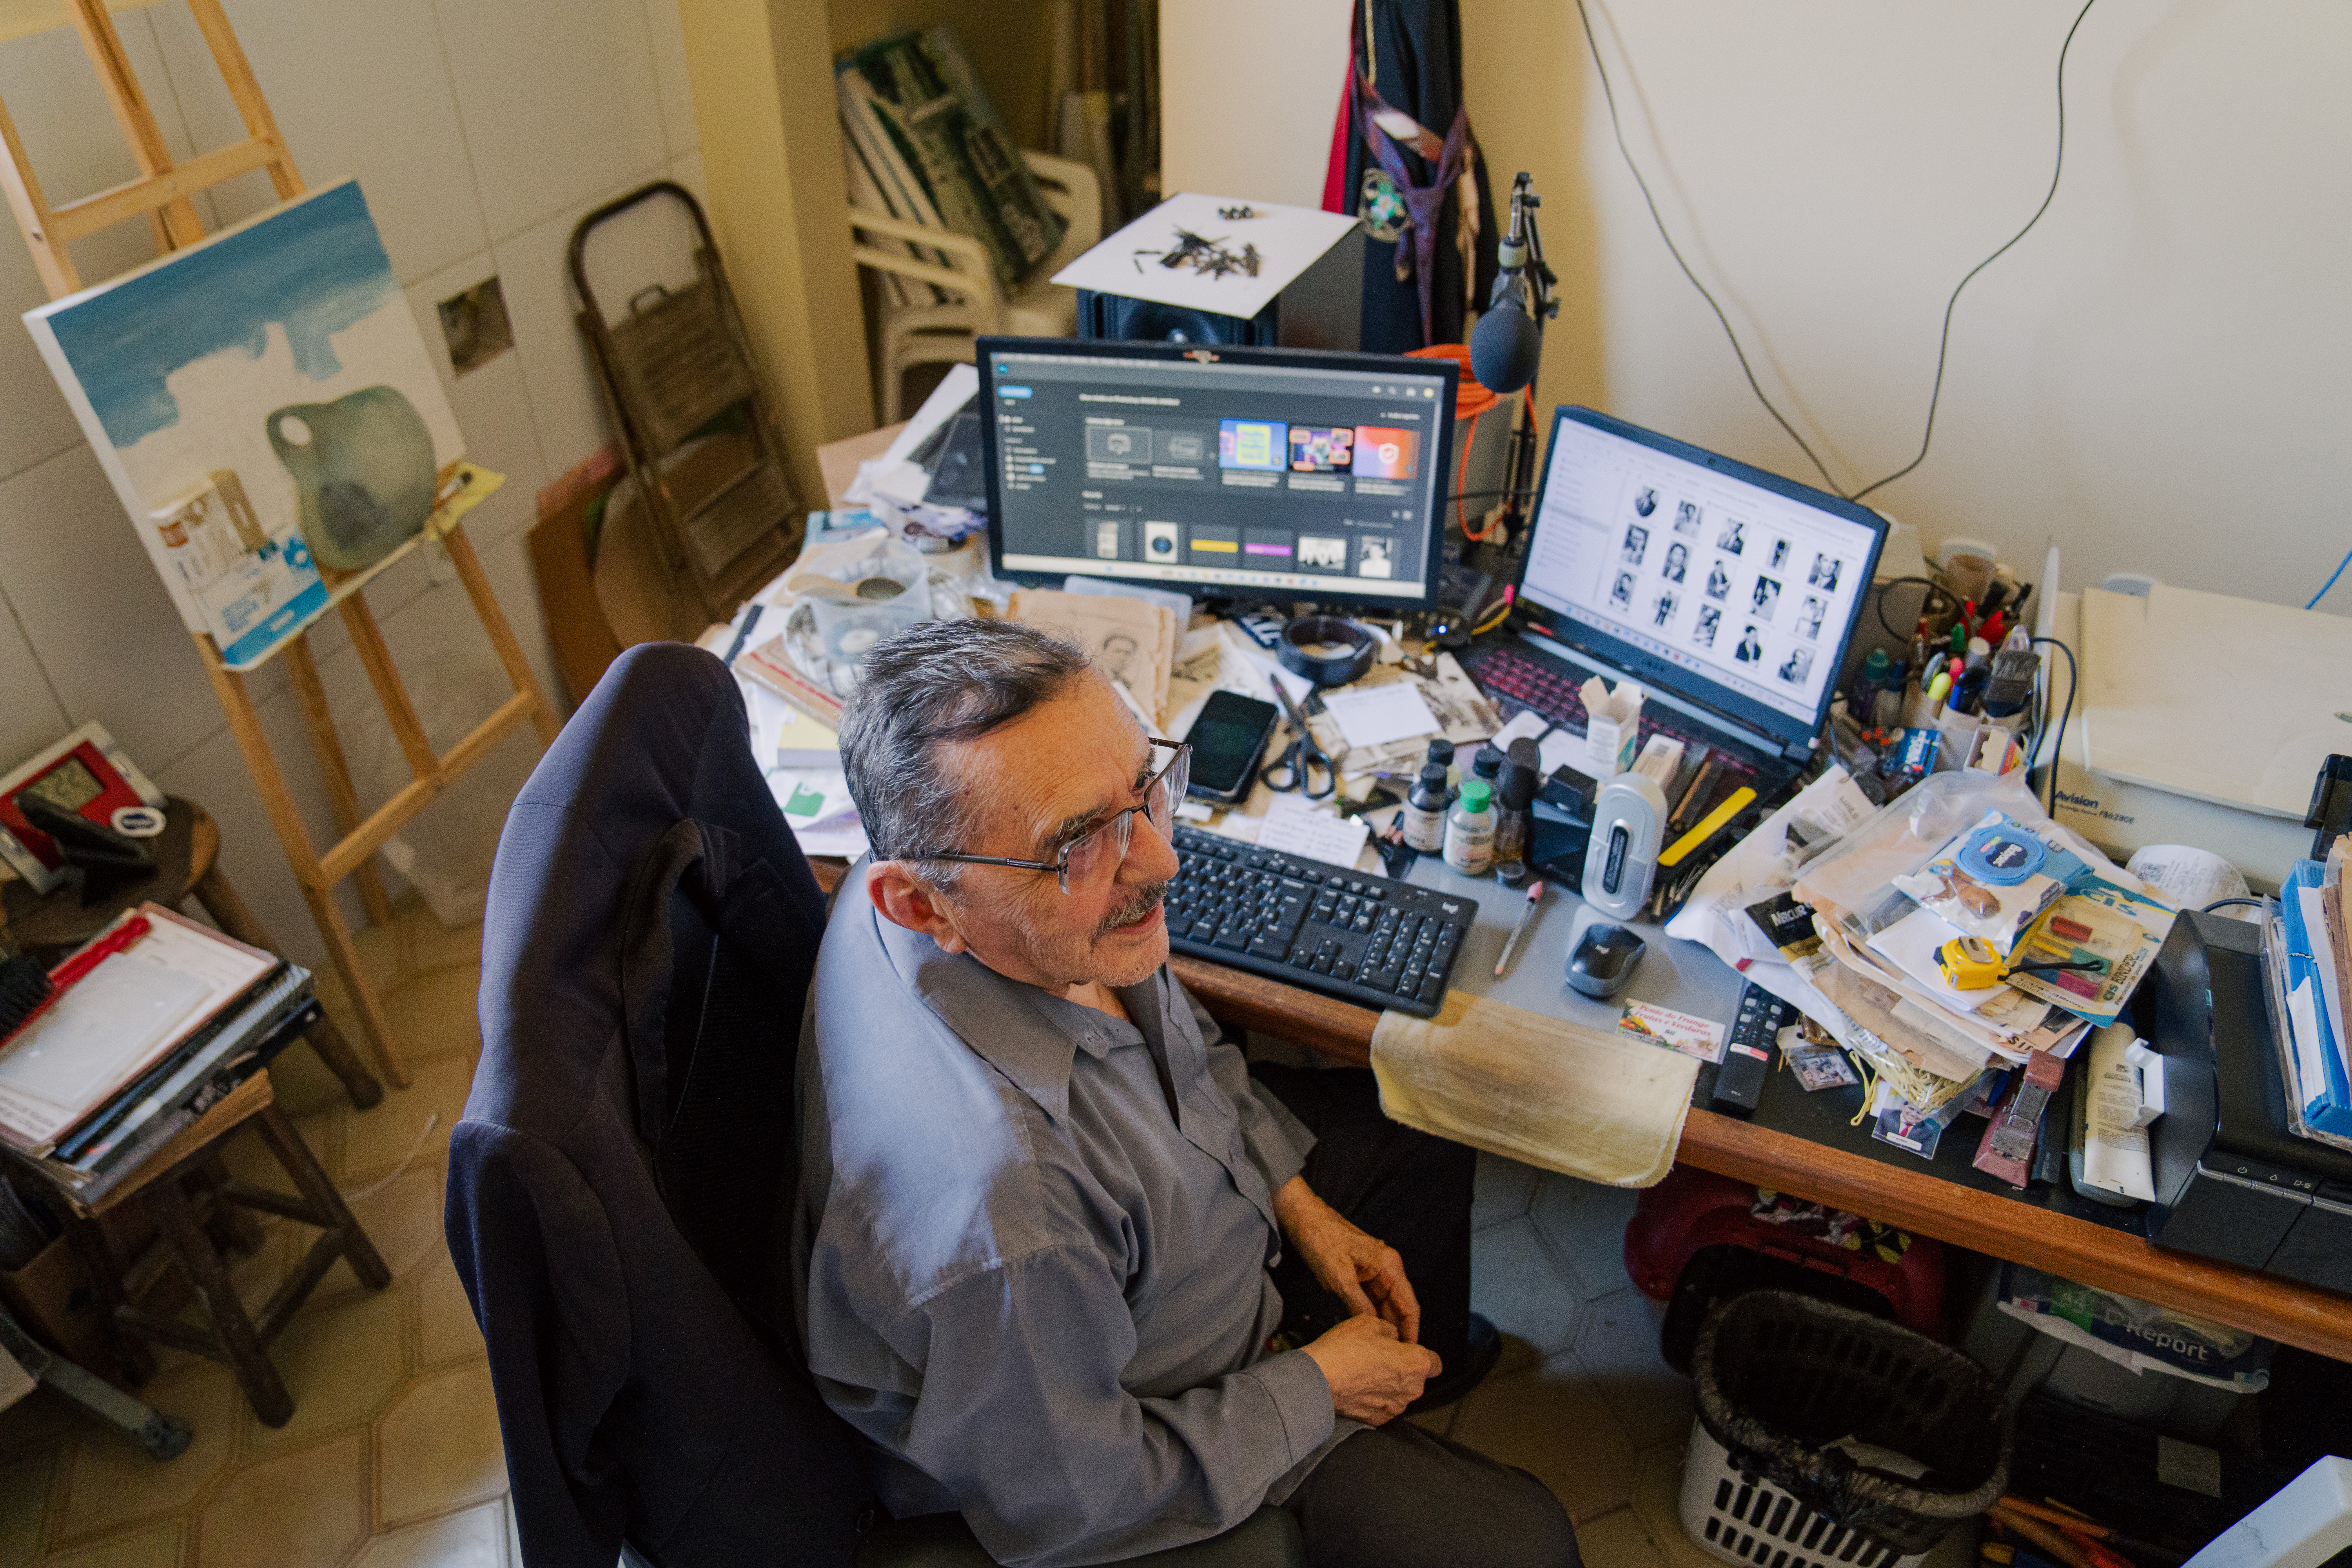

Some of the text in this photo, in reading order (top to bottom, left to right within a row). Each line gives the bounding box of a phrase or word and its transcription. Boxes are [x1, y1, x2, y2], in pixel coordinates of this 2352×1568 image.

[2055, 790, 2098, 809] Avision
[1442, 902, 1459, 914] logi
[1595, 944, 1610, 955] logi
[2111, 954, 2136, 985] BINDER
[1635, 1011, 1662, 1023] Frutas
[1671, 1021, 1711, 1036] Verduras
[1640, 1005, 1663, 1015] Ponto
[1678, 1015, 1710, 1028] Frango
[2297, 1008, 2310, 1081] AEROPORTO
[2126, 1319, 2209, 1361] Report
